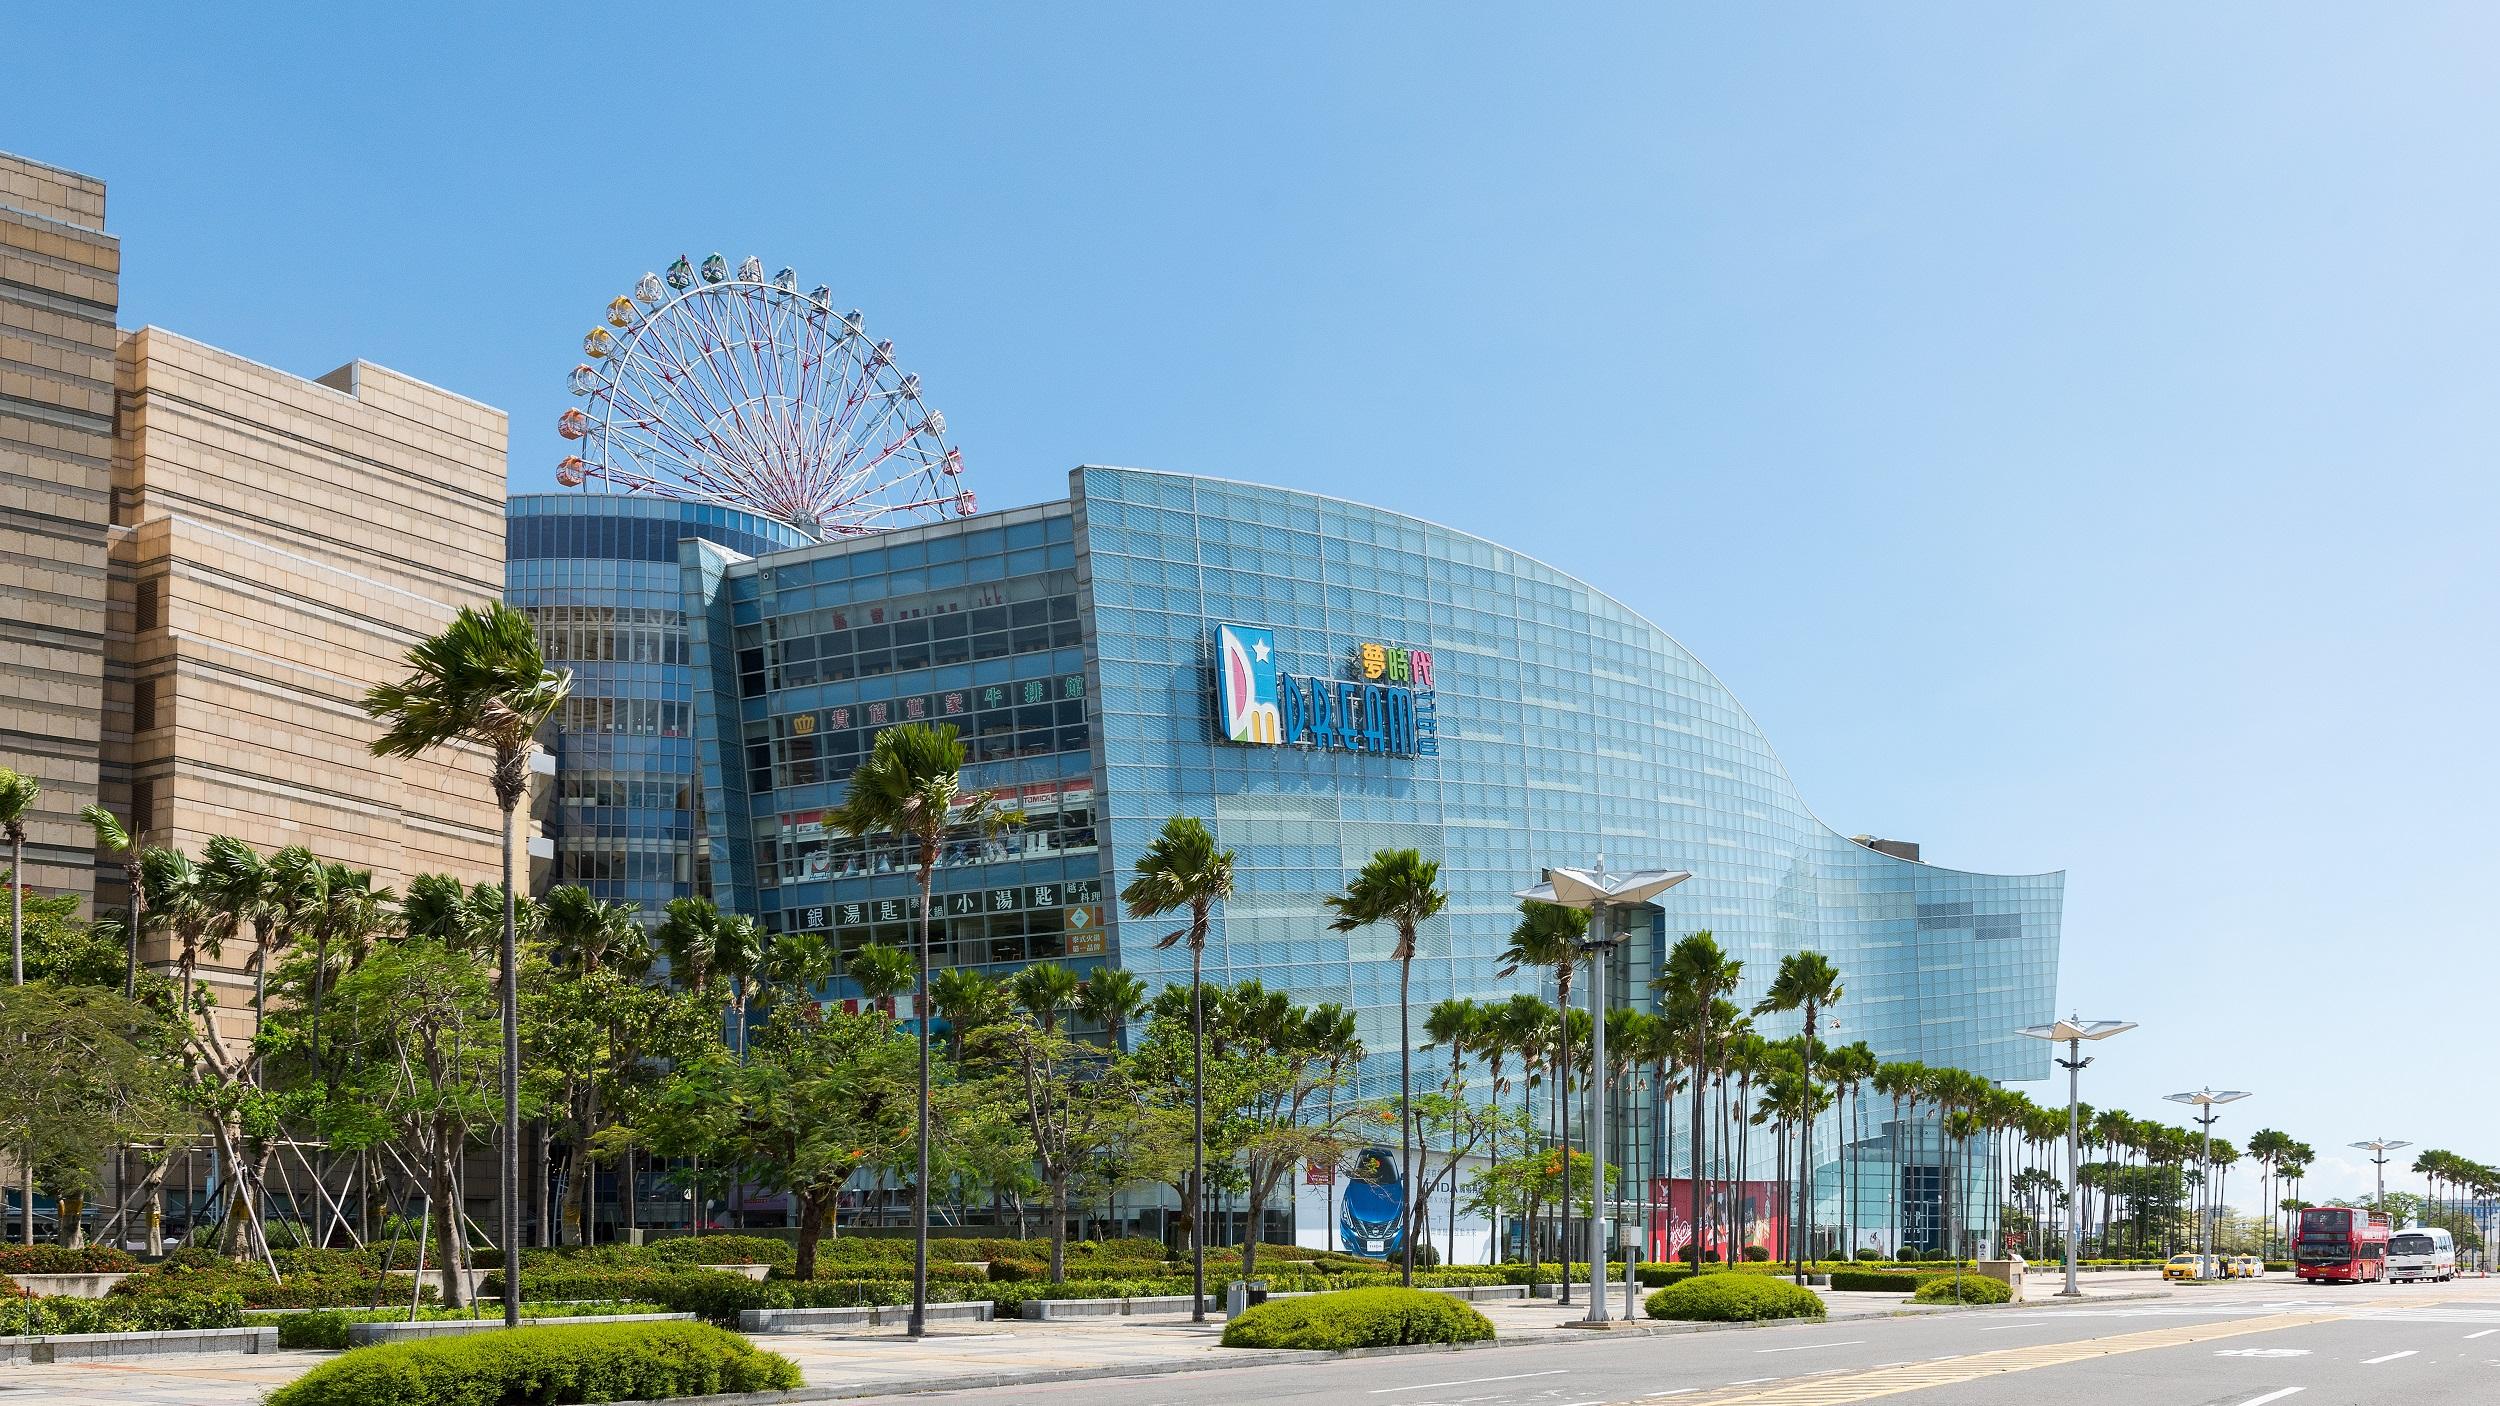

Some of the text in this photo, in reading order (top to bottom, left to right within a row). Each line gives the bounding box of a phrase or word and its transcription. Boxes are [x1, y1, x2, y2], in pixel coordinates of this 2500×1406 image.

[1360, 642, 1434, 686] 夢時代
[1282, 671, 1439, 756] DREAM MALL
[956, 886, 1053, 914] 小湯匙
[1080, 891, 1101, 903] 料理
[806, 900, 899, 928] 銀湯匙
[1423, 1181, 1458, 1193] TIDA
